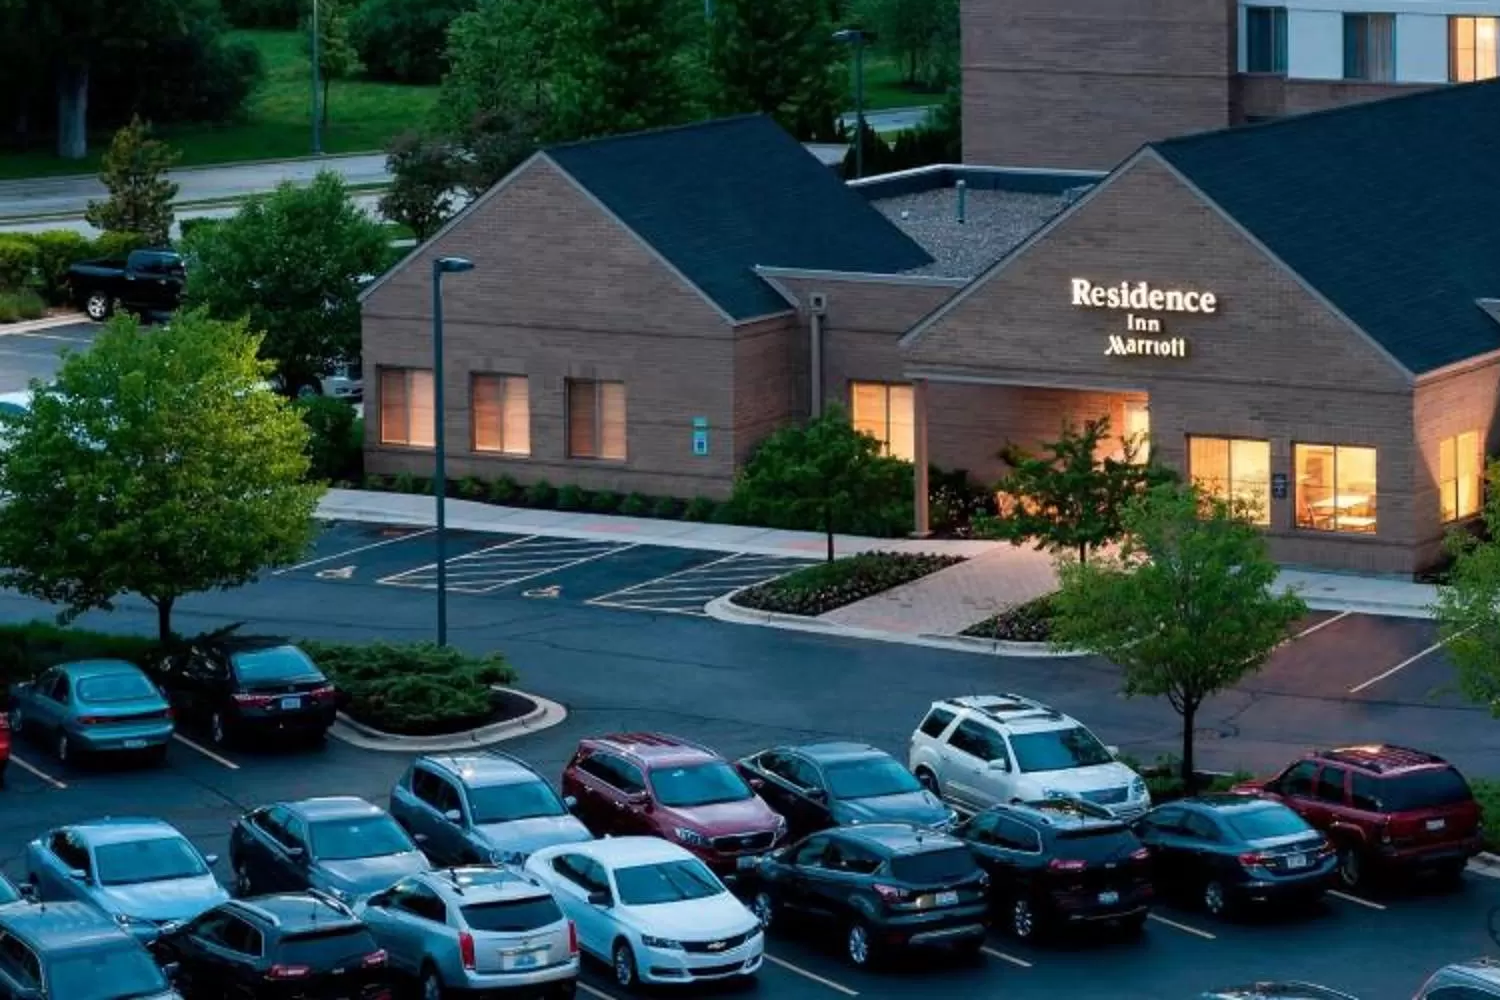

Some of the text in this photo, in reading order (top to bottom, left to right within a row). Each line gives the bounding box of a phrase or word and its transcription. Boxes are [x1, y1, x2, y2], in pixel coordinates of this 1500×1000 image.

[1071, 277, 1217, 313] Residence
[1127, 313, 1160, 332] Inn
[1104, 335, 1185, 356] Marriott
